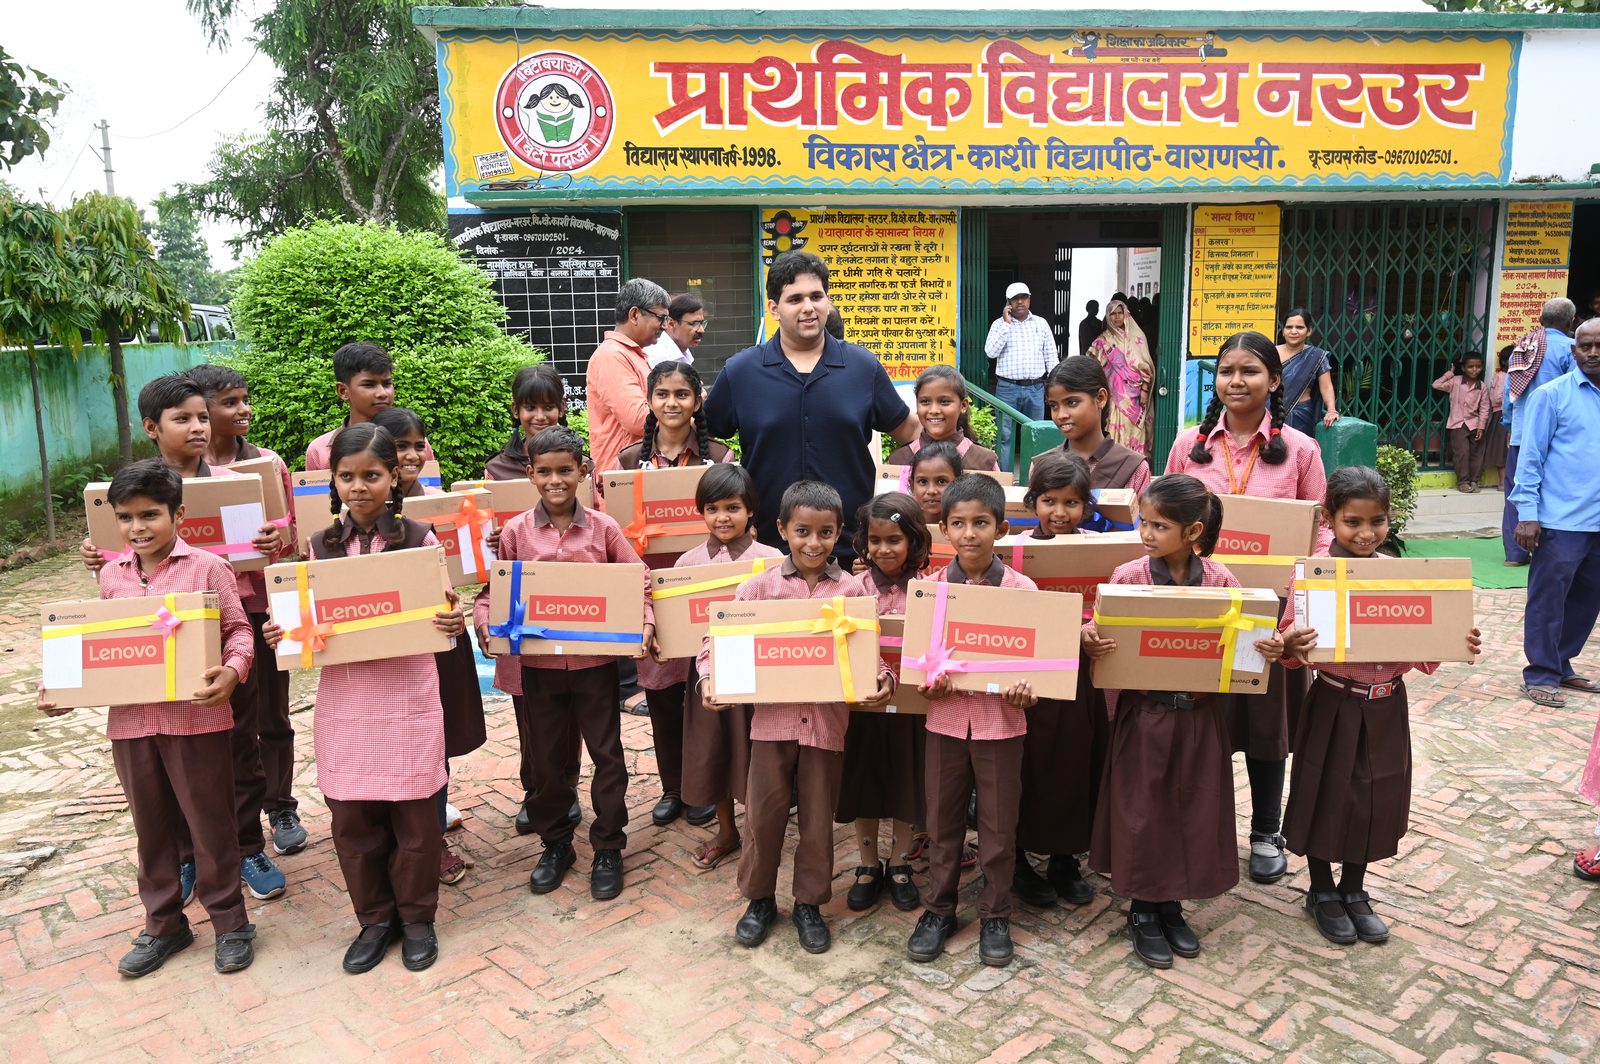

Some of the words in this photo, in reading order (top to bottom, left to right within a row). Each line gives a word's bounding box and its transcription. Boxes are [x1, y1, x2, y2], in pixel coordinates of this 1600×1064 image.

[650, 40, 973, 134] प्राथमिक
[981, 40, 1248, 129] विद्यालय
[1258, 62, 1485, 129] नरउर
[623, 141, 679, 171] विद्यालय
[679, 147, 724, 169] स्थापना
[803, 133, 900, 172] विकास
[1196, 238, 1200, 246] 1
[1195, 250, 1201, 259] 2
[1194, 268, 1200, 277] 3
[1192, 327, 1198, 336] 5
[178, 525, 215, 538] ovo
[1219, 537, 1262, 553] novo
[665, 575, 692, 583] chromebook
[322, 601, 394, 622] Lenovo
[536, 600, 600, 617] Lenovo
[725, 611, 756, 619] chromebook
[1356, 601, 1425, 618] Lenovo
[57, 613, 87, 621] chromebook
[955, 628, 1027, 650] Lenovo
[1148, 637, 1221, 654] Lenovo
[89, 643, 158, 662] Lenovo
[758, 644, 827, 660] Lenovo
